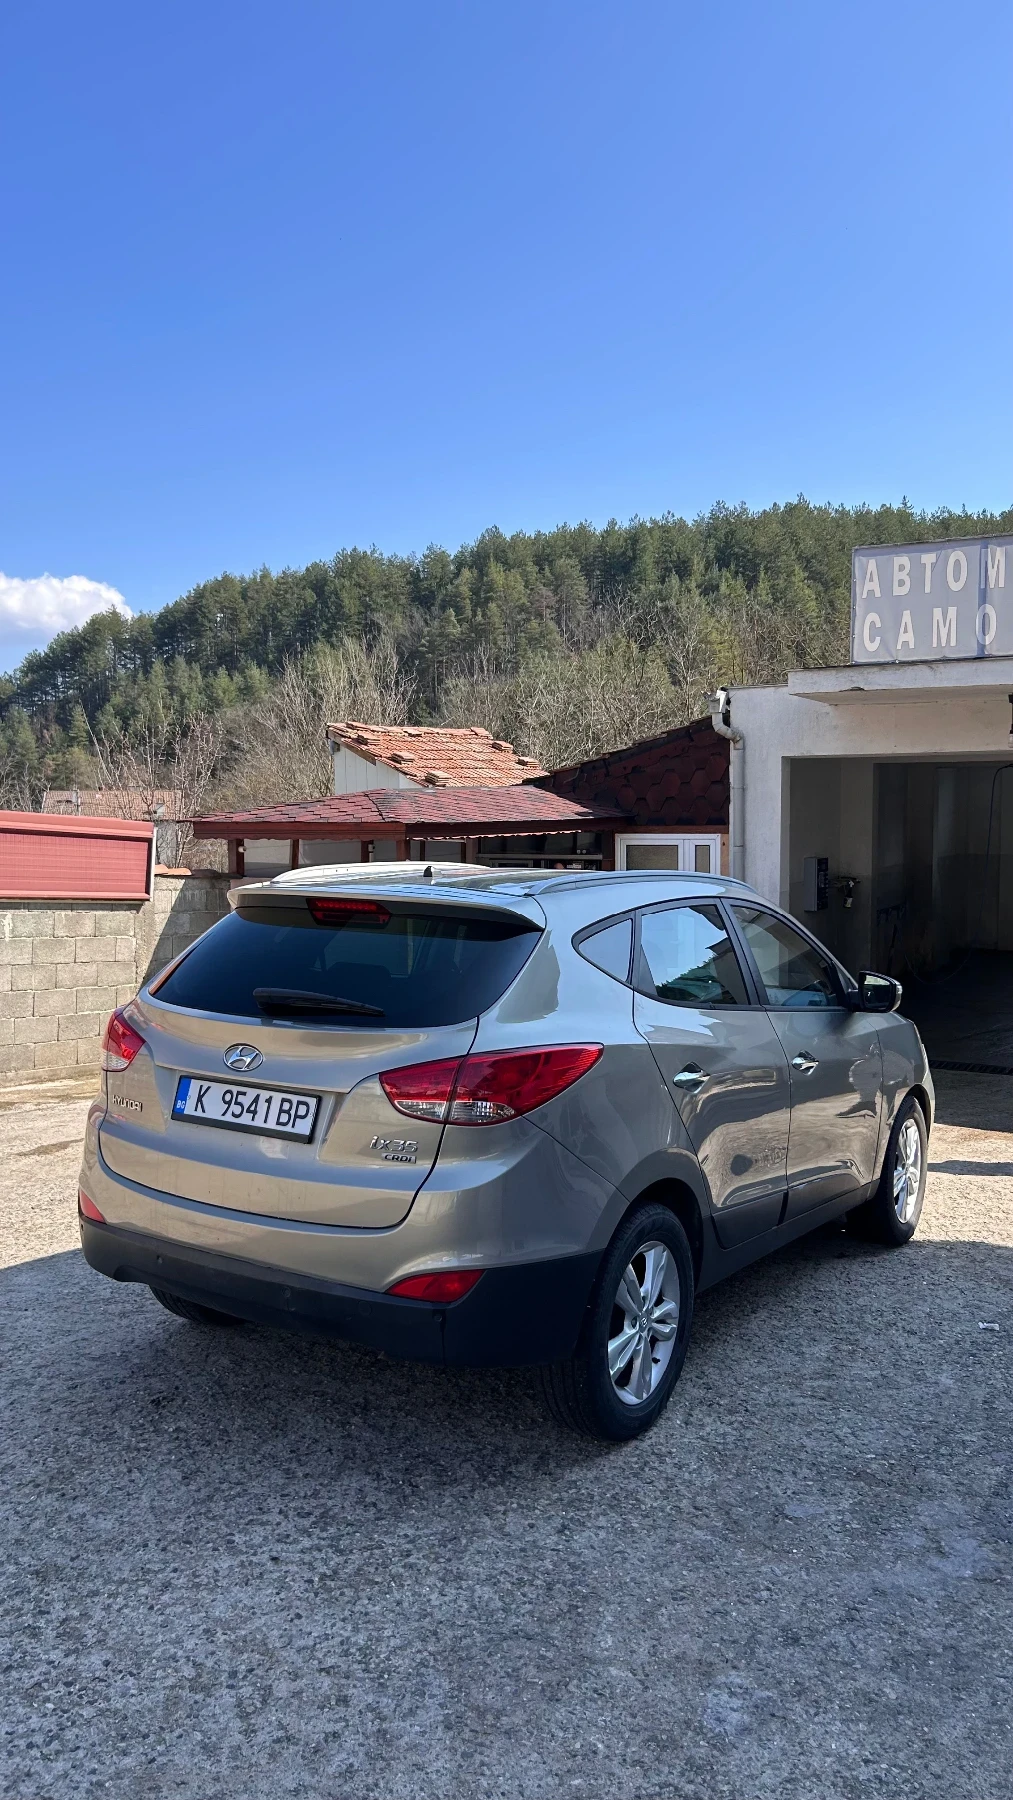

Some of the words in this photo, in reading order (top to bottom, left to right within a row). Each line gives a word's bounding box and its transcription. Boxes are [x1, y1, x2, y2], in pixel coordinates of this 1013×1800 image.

[862, 546, 1005, 598] АВТОМ
[863, 603, 997, 652] САМО
[112, 1094, 143, 1112] HYUNDAI
[177, 1100, 186, 1109] BG
[194, 1084, 211, 1113] K
[370, 1135, 418, 1152] ix35
